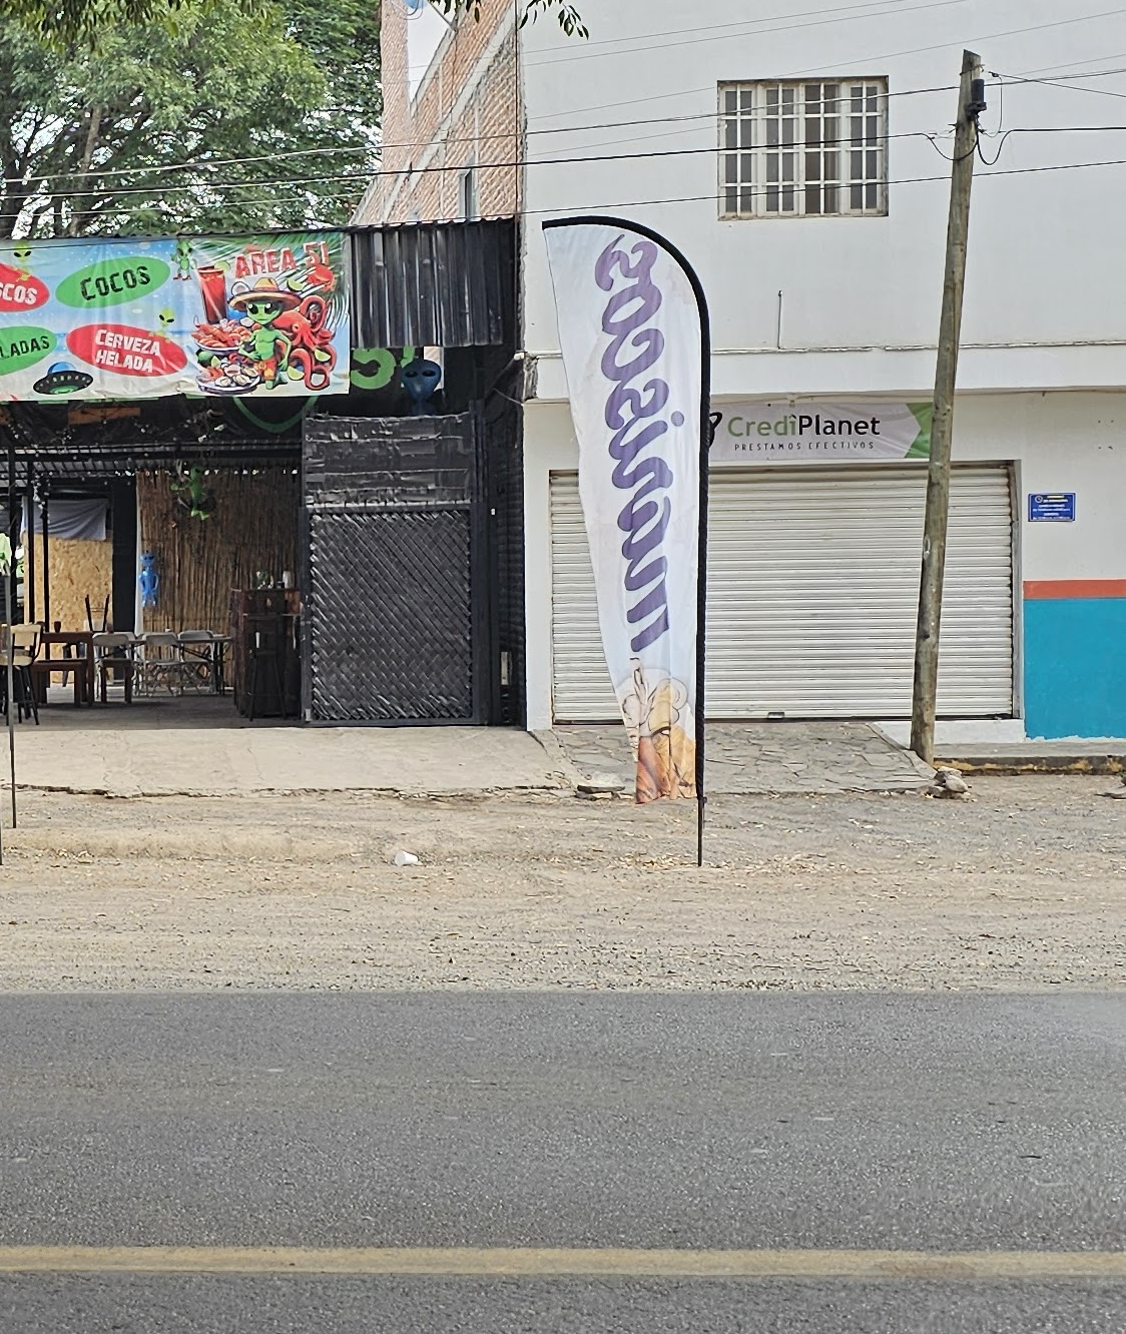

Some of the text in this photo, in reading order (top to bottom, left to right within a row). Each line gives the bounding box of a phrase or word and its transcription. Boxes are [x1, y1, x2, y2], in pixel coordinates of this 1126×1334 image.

[235, 241, 330, 278] AREA 51
[80, 266, 151, 300] COCOS
[95, 329, 161, 356] CERVEZA
[96, 350, 153, 373] HELADA
[734, 441, 874, 451] PRESTAMOS EFECTIVOS
